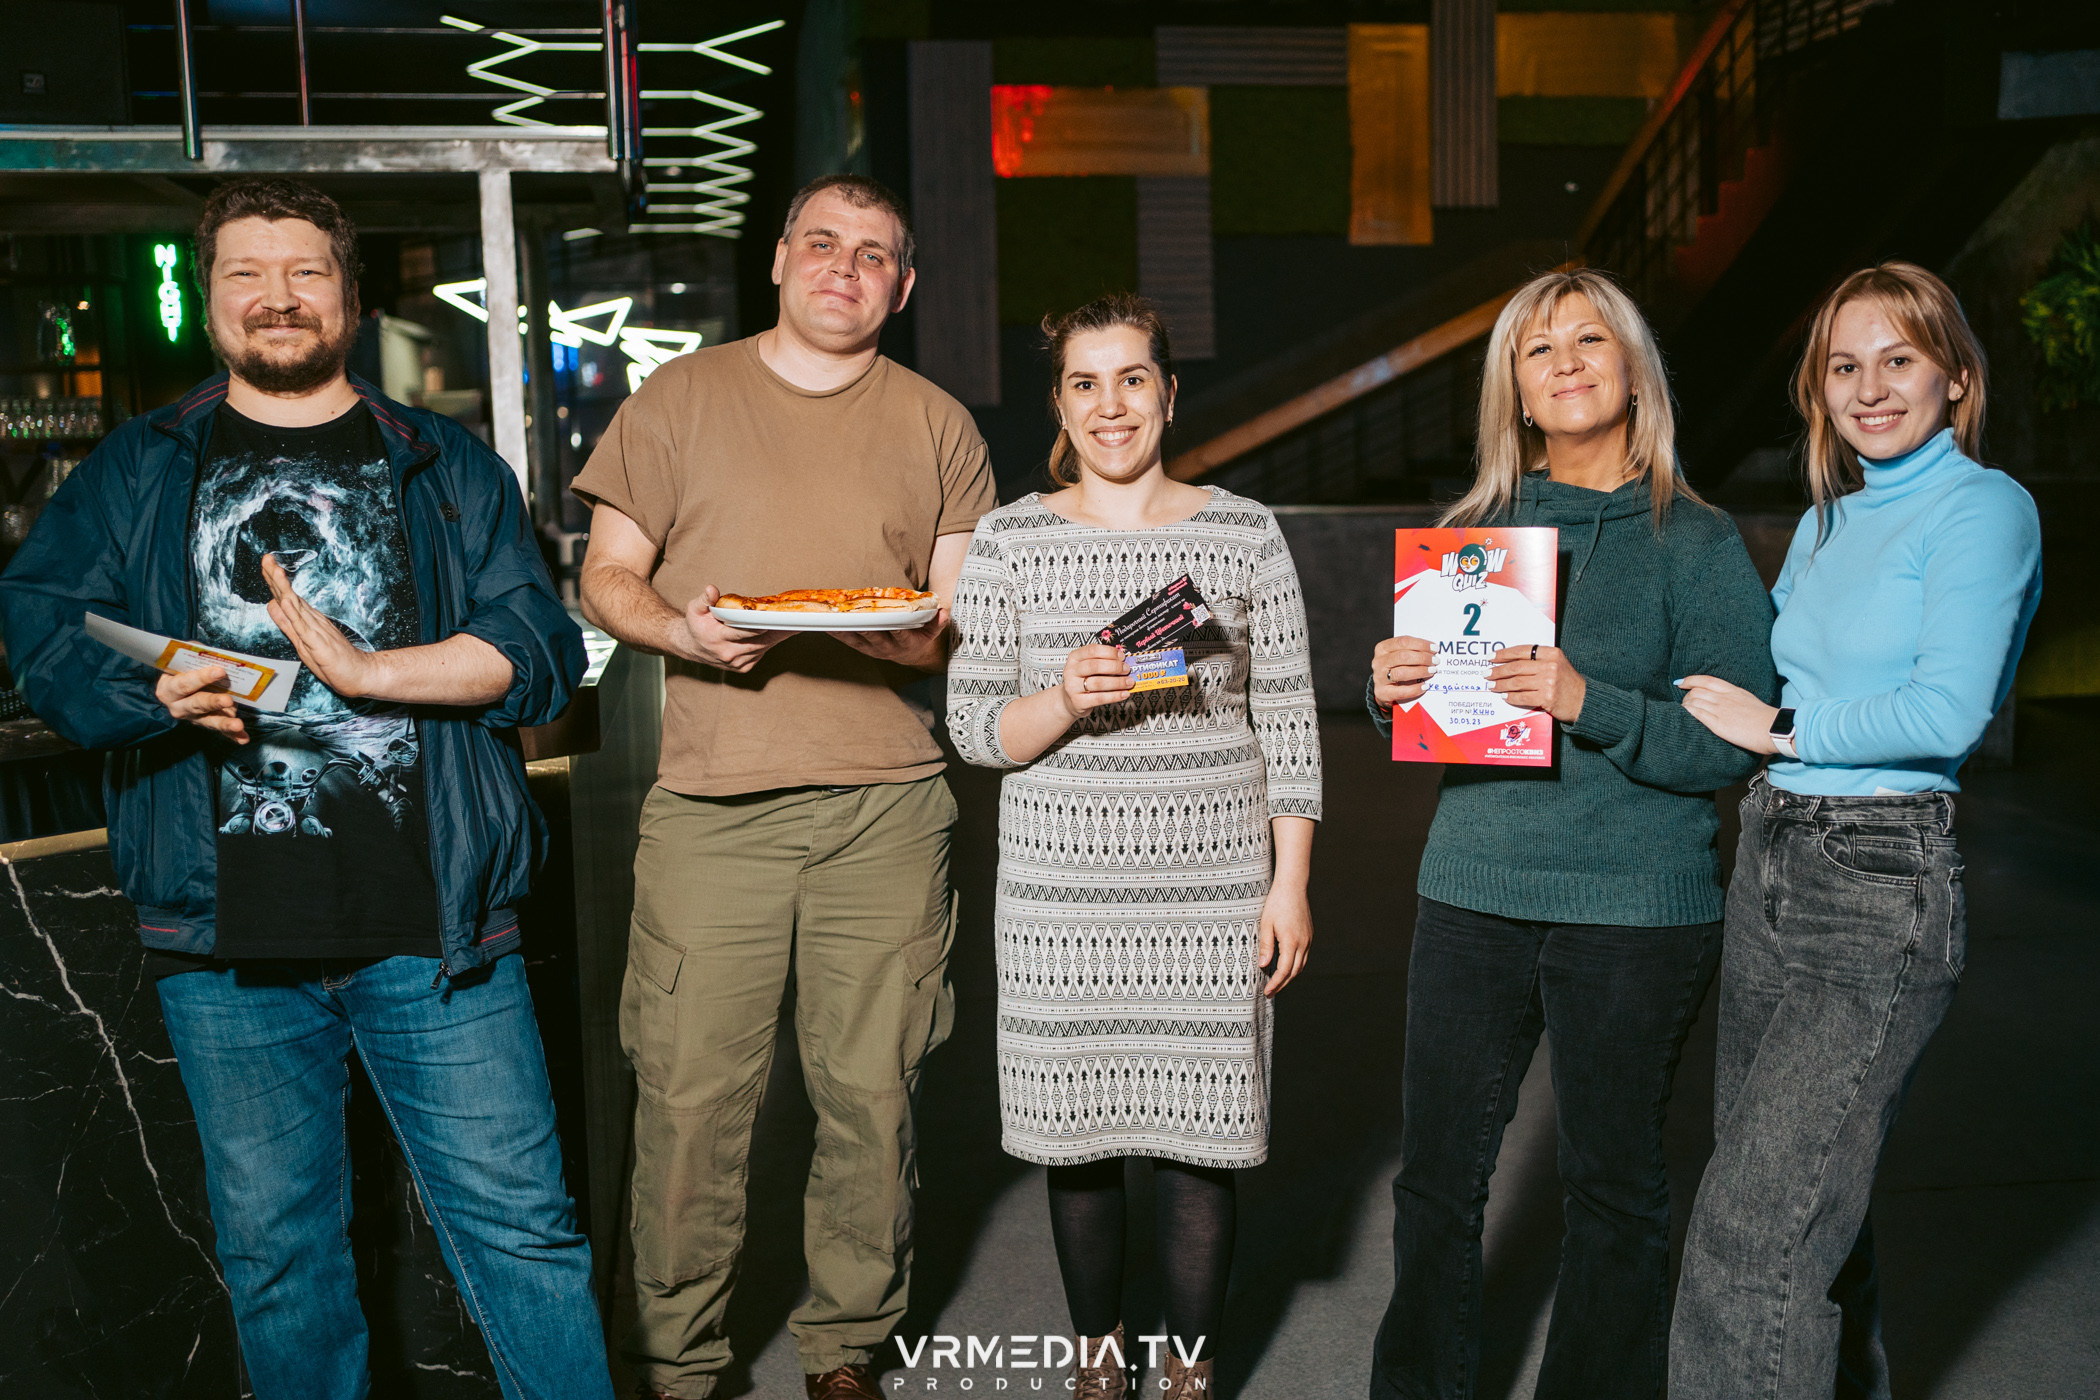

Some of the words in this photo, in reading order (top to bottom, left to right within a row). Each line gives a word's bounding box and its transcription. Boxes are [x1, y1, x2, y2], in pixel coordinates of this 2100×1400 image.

[154, 243, 182, 342] NIGHT
[1452, 572, 1488, 592] QUIZ
[1463, 603, 1481, 636] 2
[1438, 641, 1506, 655] МЕСТО
[1130, 659, 1178, 674] РТИФИКАТ
[1449, 717, 1481, 725] 30.03.23
